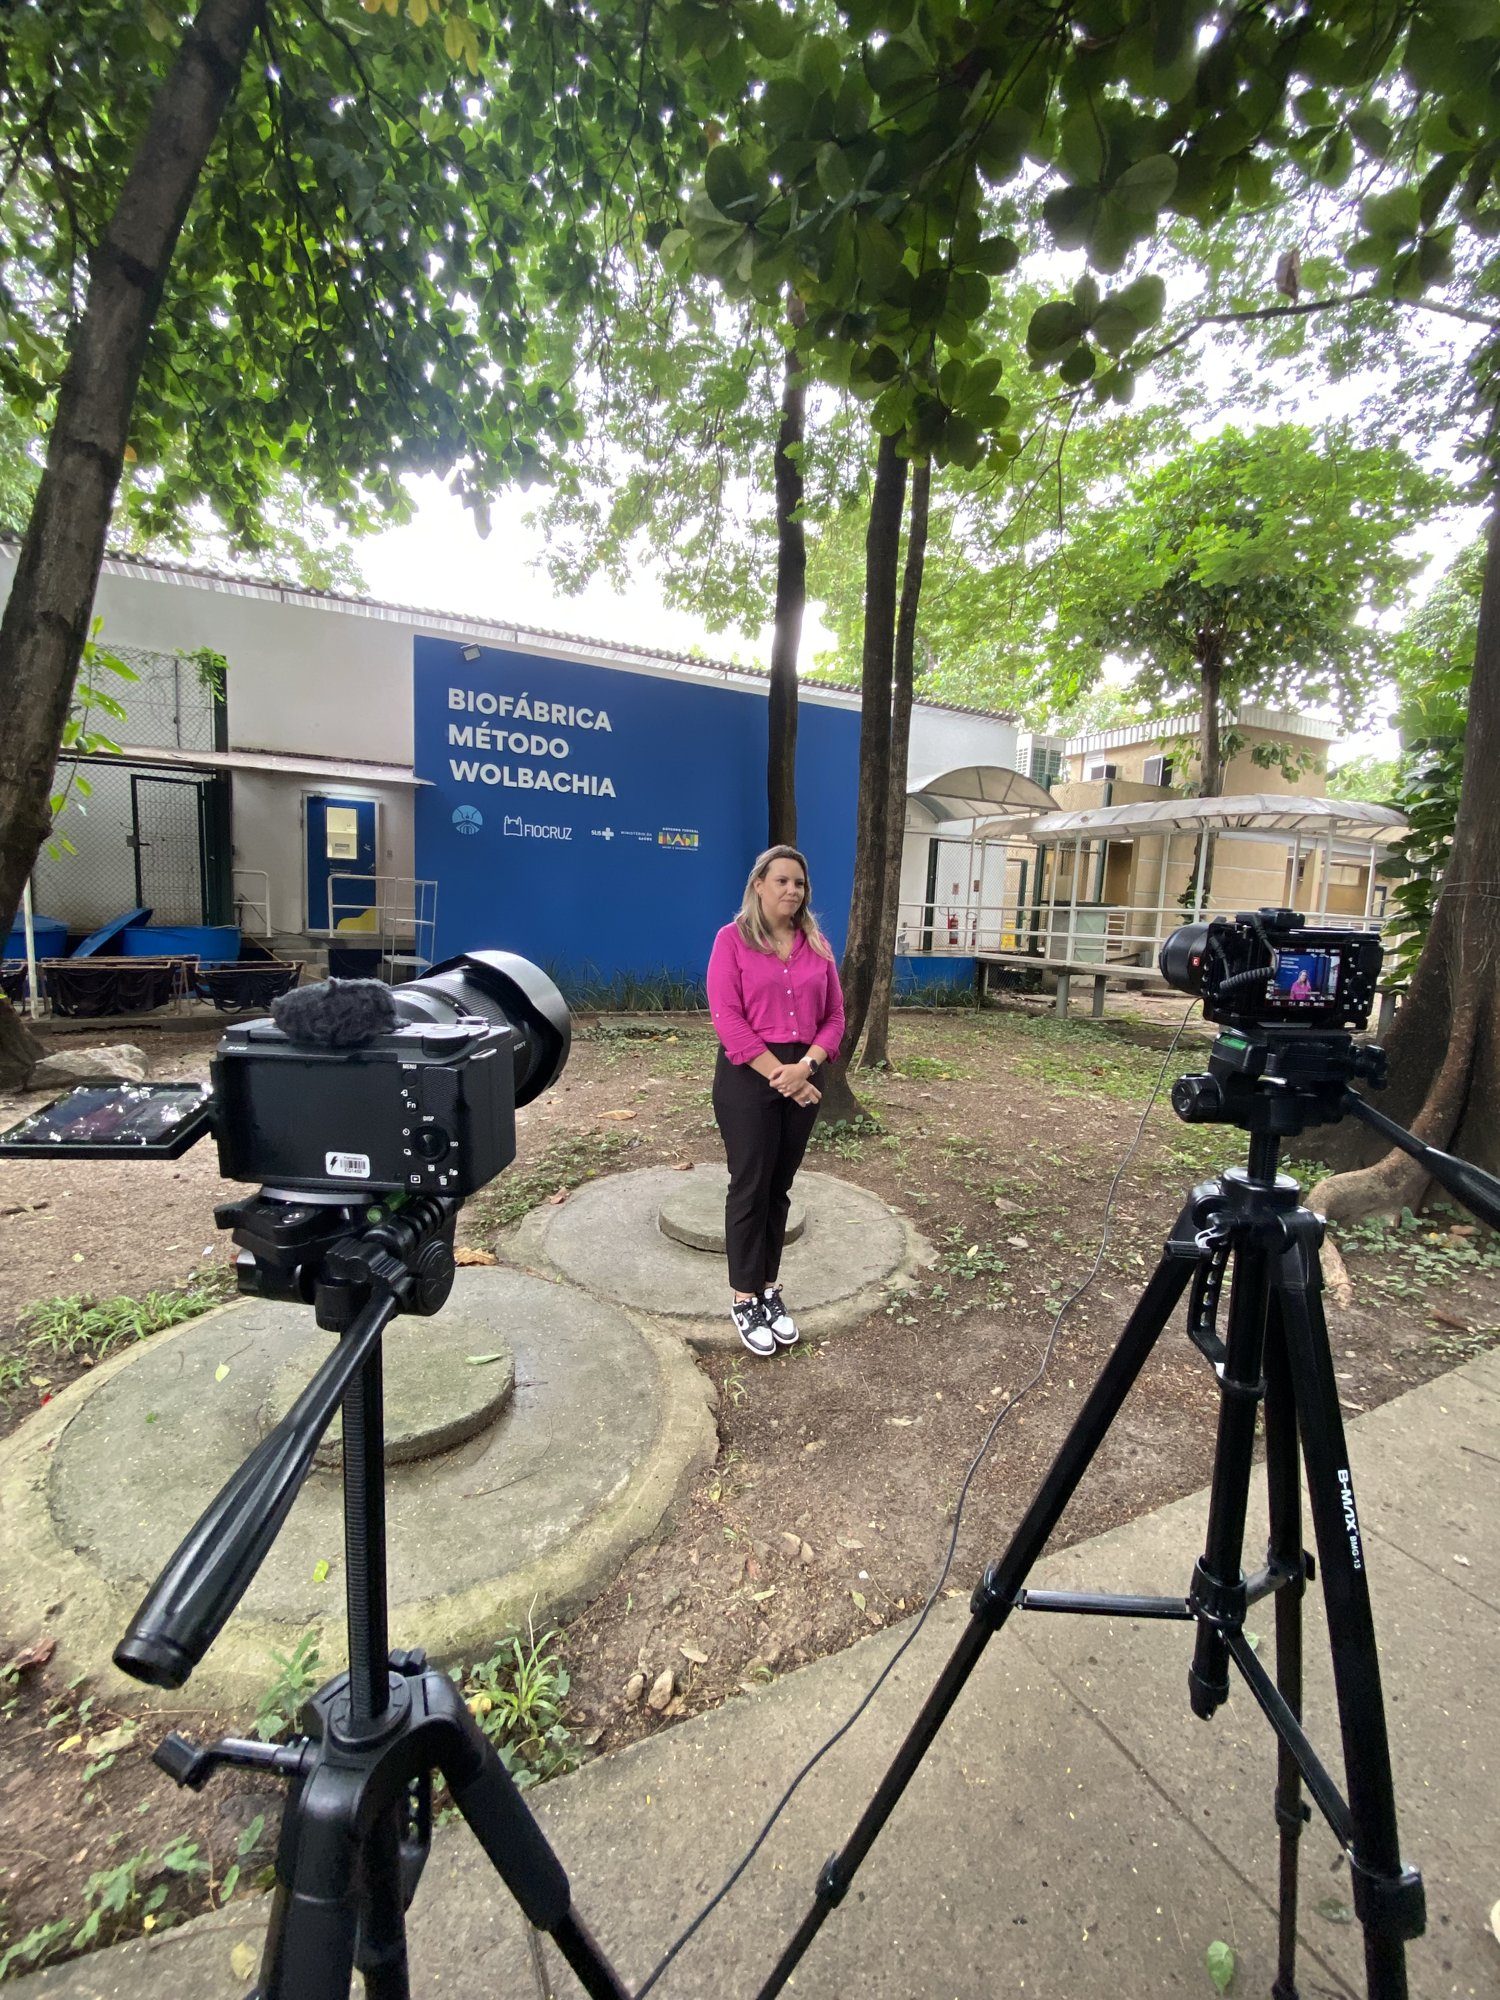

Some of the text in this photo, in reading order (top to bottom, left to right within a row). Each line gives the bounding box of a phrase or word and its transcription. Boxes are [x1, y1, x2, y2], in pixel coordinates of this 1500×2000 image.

[448, 687, 613, 733] BIOFÁBRICA
[448, 721, 570, 760] MÉTODO
[449, 759, 617, 798] WOLBACHIA
[524, 823, 573, 841] FIOCRUZ
[406, 1101, 417, 1109] Fn
